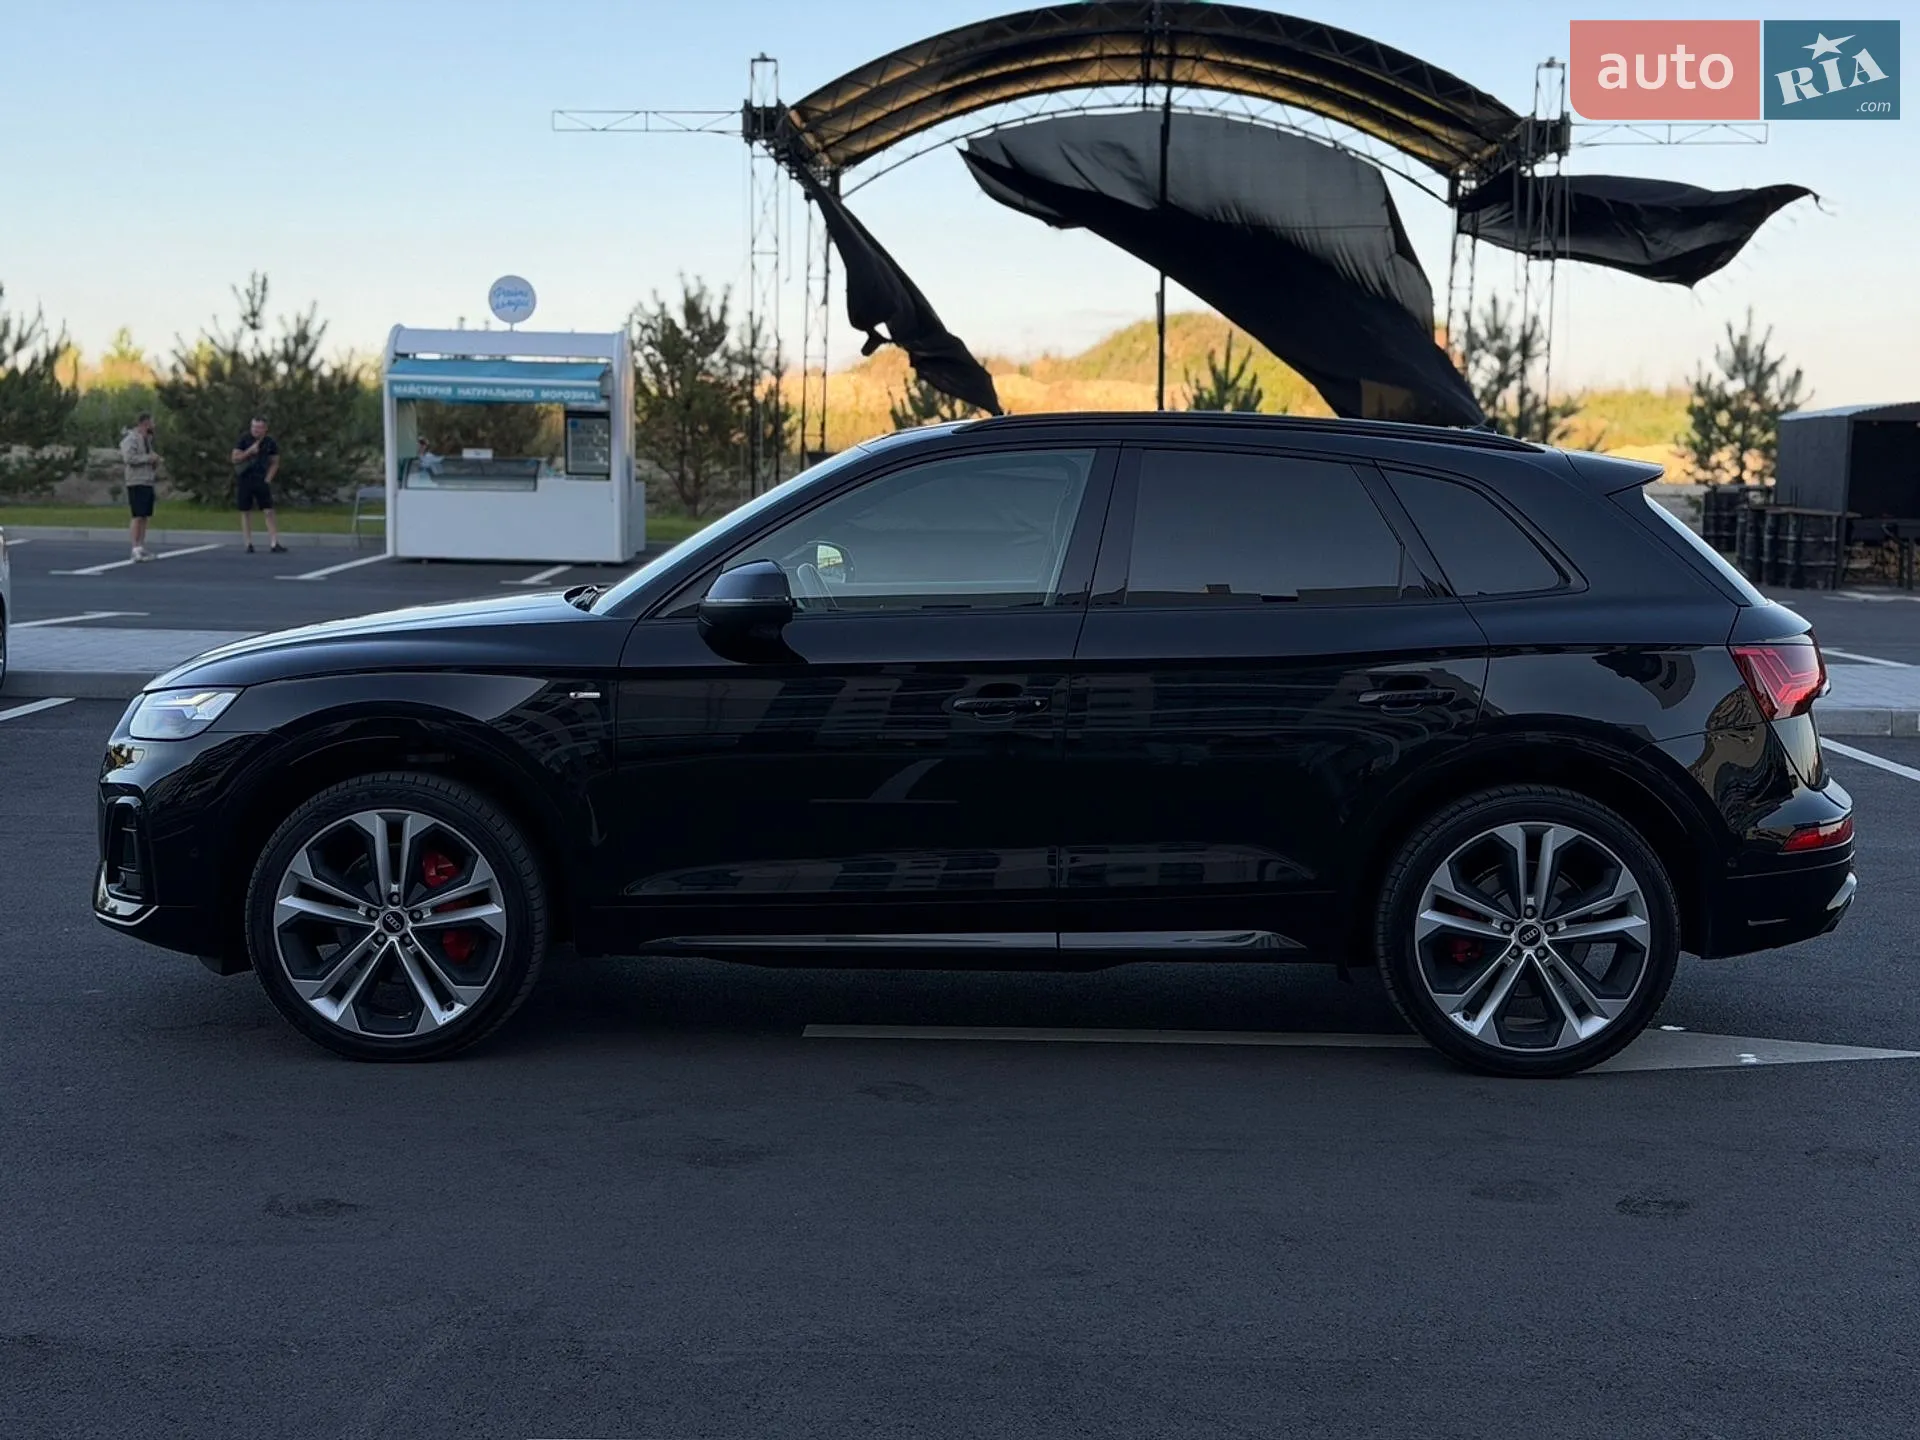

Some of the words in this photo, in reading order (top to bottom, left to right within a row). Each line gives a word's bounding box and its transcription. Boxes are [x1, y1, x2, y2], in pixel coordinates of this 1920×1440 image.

[393, 384, 453, 396] МАЙСТЕРНЯ
[457, 387, 534, 398] НАТУРАЛЬНОГО
[541, 389, 596, 401] МОРОЗИВА
